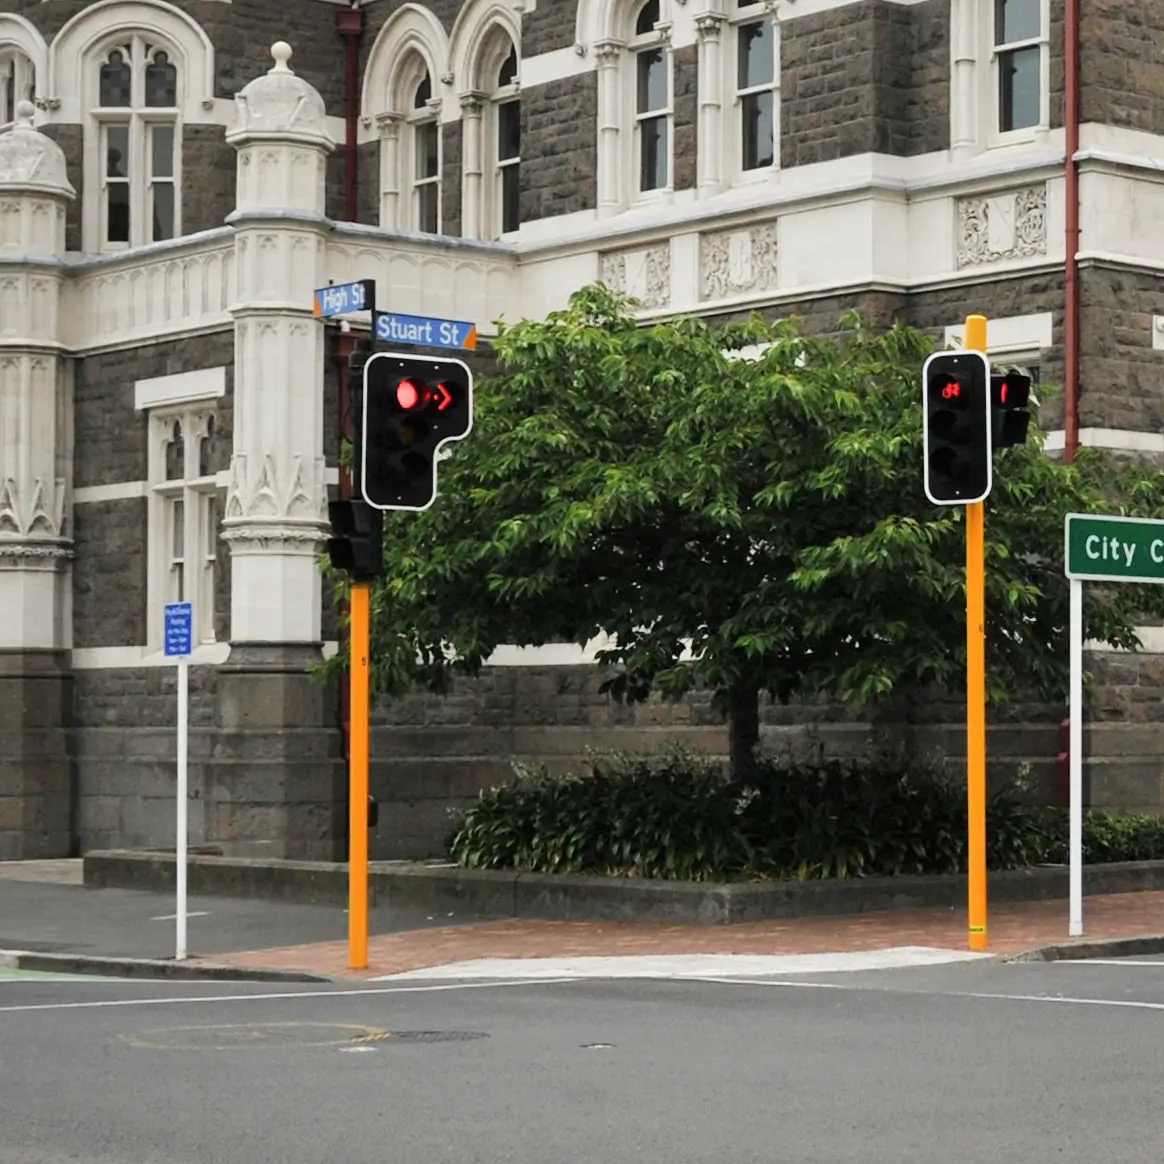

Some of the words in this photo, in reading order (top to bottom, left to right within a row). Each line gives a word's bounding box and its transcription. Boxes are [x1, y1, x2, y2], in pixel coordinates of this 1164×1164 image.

[323, 287, 348, 313] High
[351, 283, 366, 305] St
[377, 315, 433, 343] Stuart
[439, 323, 459, 346] St
[1085, 534, 1137, 567] City
